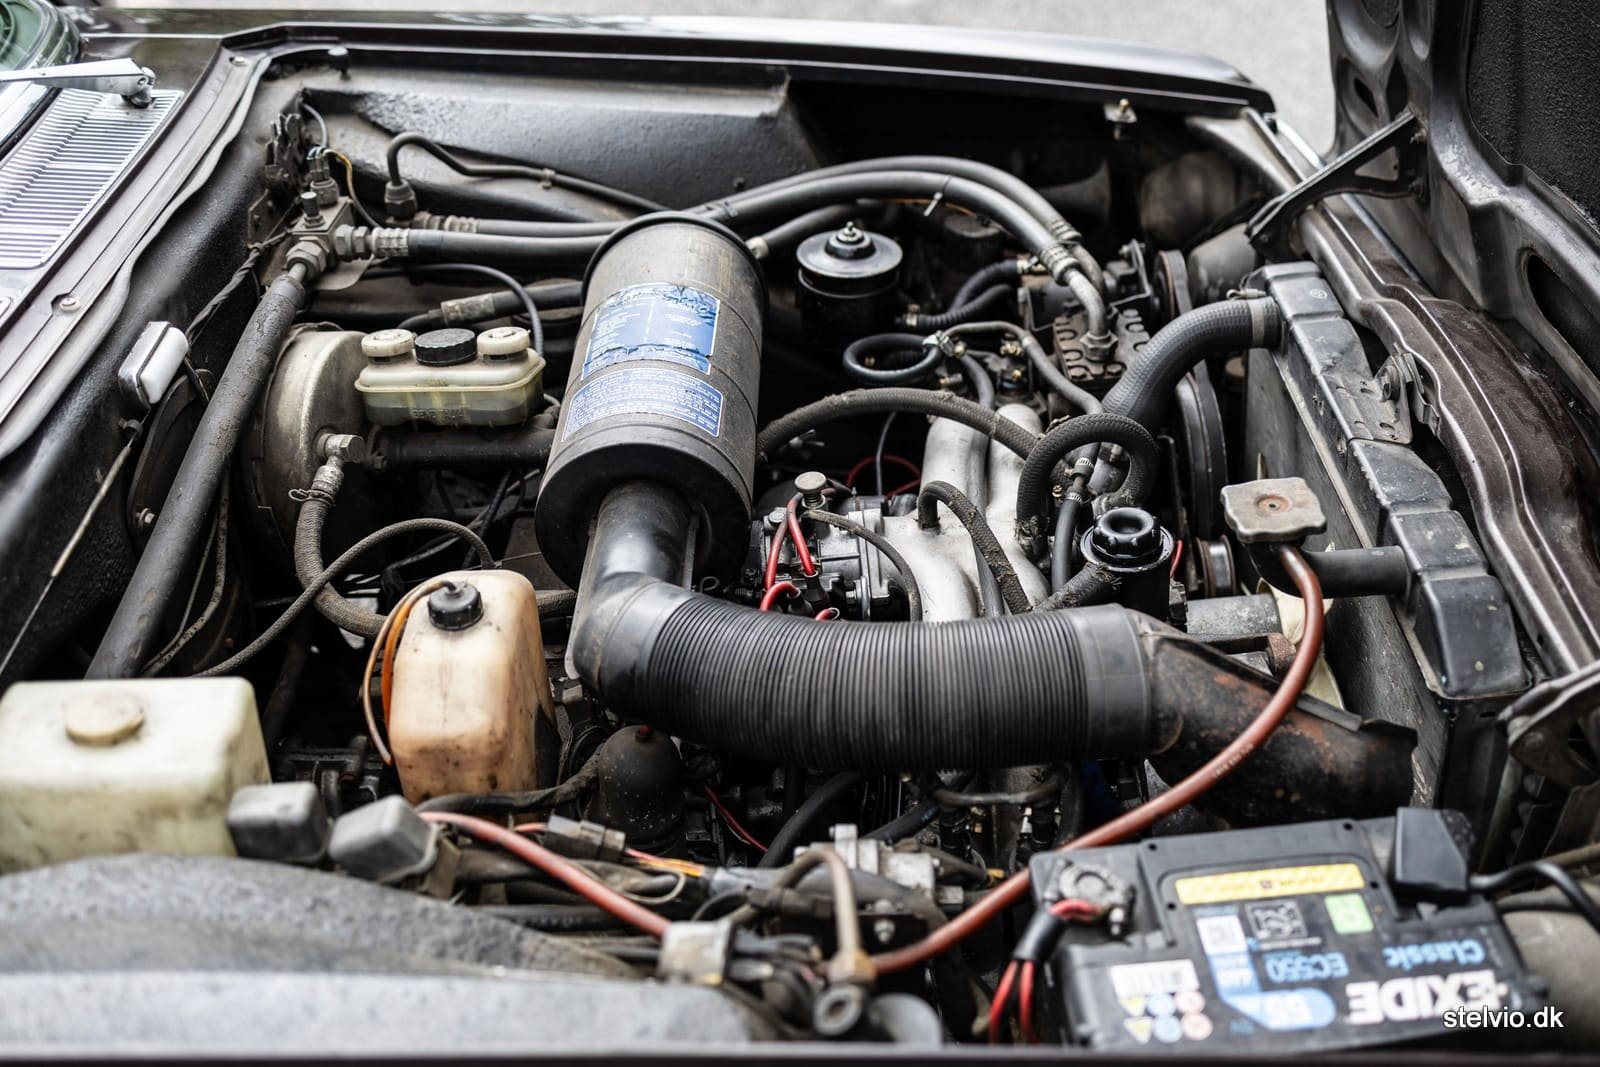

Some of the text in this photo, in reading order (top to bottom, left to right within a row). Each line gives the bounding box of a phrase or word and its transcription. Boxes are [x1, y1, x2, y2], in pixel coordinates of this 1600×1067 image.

[1265, 952, 1349, 984] EC550
[1383, 938, 1486, 972] Classic
[1346, 969, 1507, 1025] EXIDE
